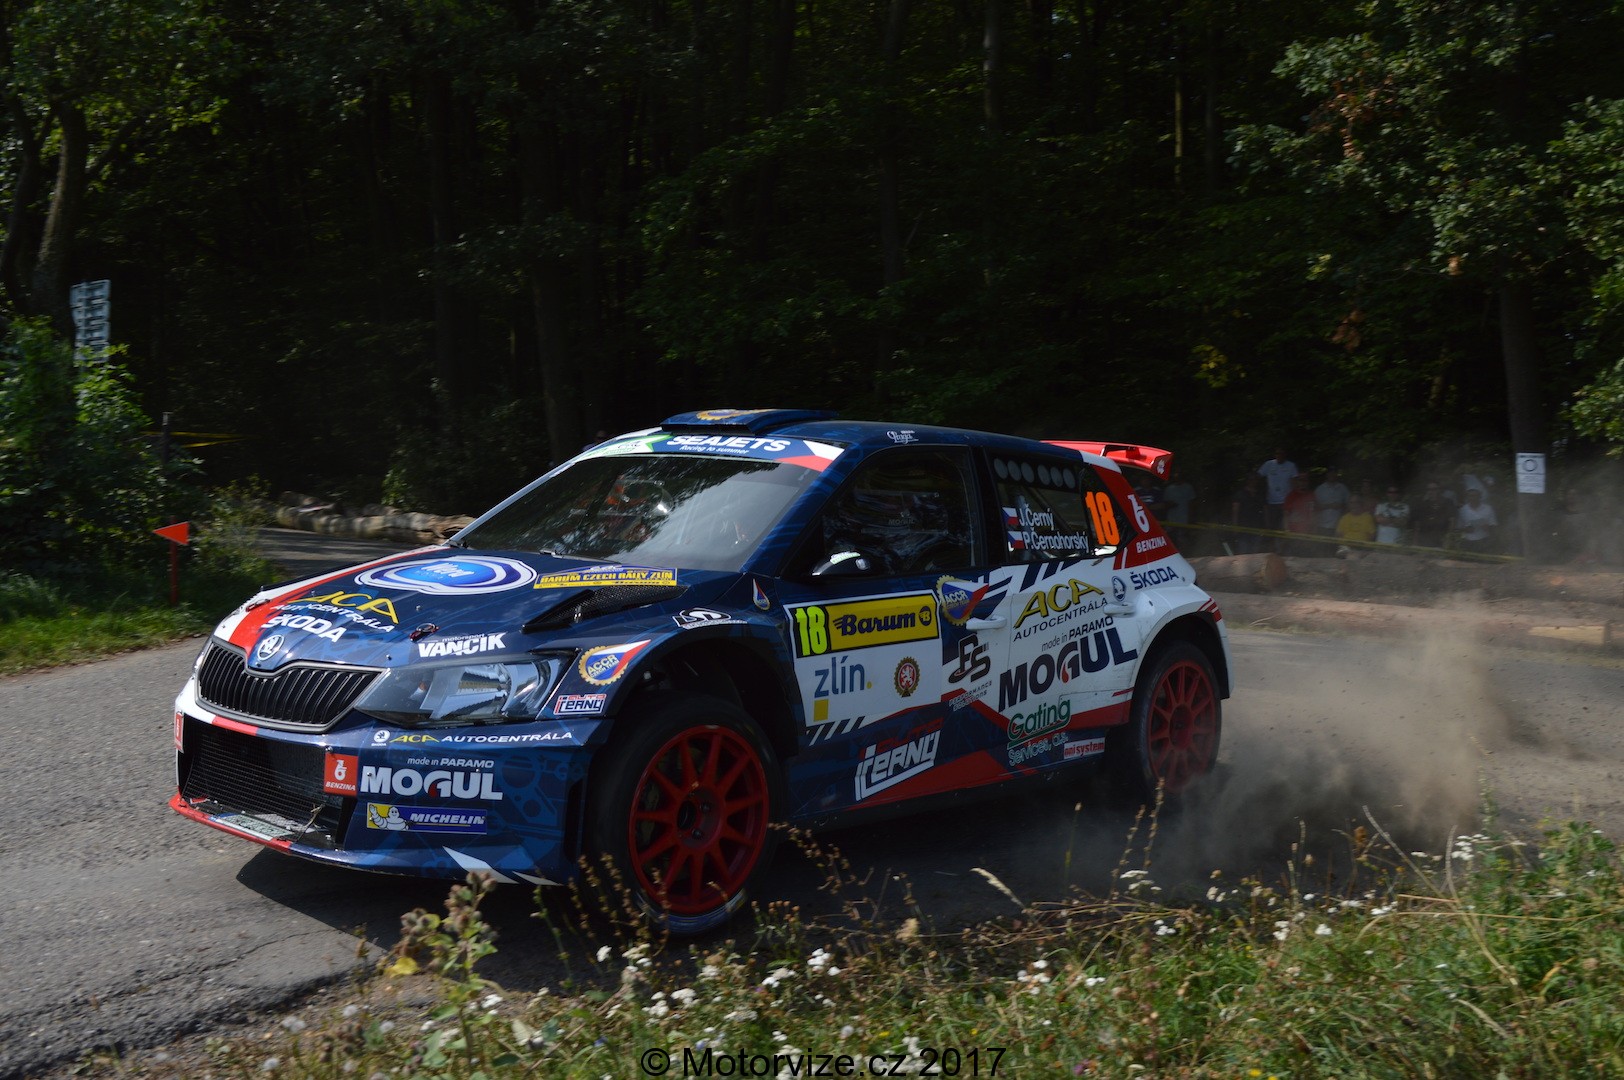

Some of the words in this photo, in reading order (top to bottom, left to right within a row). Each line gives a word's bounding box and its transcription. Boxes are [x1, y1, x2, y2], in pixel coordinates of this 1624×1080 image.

[667, 434, 791, 452] SEAJETS
[716, 447, 750, 455] summer
[1085, 491, 1120, 545] 18
[1136, 536, 1167, 553] BENZINA
[583, 572, 616, 581] CZECH
[1130, 566, 1179, 590] ŠKODA
[287, 591, 398, 624] ACA
[944, 590, 969, 605] ACCR
[1013, 578, 1105, 629] ACA
[261, 612, 347, 642] ŠKODA
[795, 606, 828, 656] 18
[833, 611, 916, 637] Barum
[1013, 596, 1108, 642] AUTOCENTRÁLA
[1042, 636, 1061, 652] made
[1061, 633, 1068, 645] in
[1069, 615, 1114, 640] PARAMO
[588, 654, 620, 676] ACCR
[998, 627, 1139, 714] MOGUL
[1007, 699, 1071, 741] Gating
[389, 733, 440, 743] ACA
[441, 731, 573, 743] AUTOCENTRÁLA
[407, 756, 430, 765] made
[431, 758, 439, 766] in
[440, 757, 494, 769] PARAMO
[326, 781, 356, 791] BENZINA
[360, 765, 504, 800] MOGUL
[409, 812, 487, 825] MICHELIN
